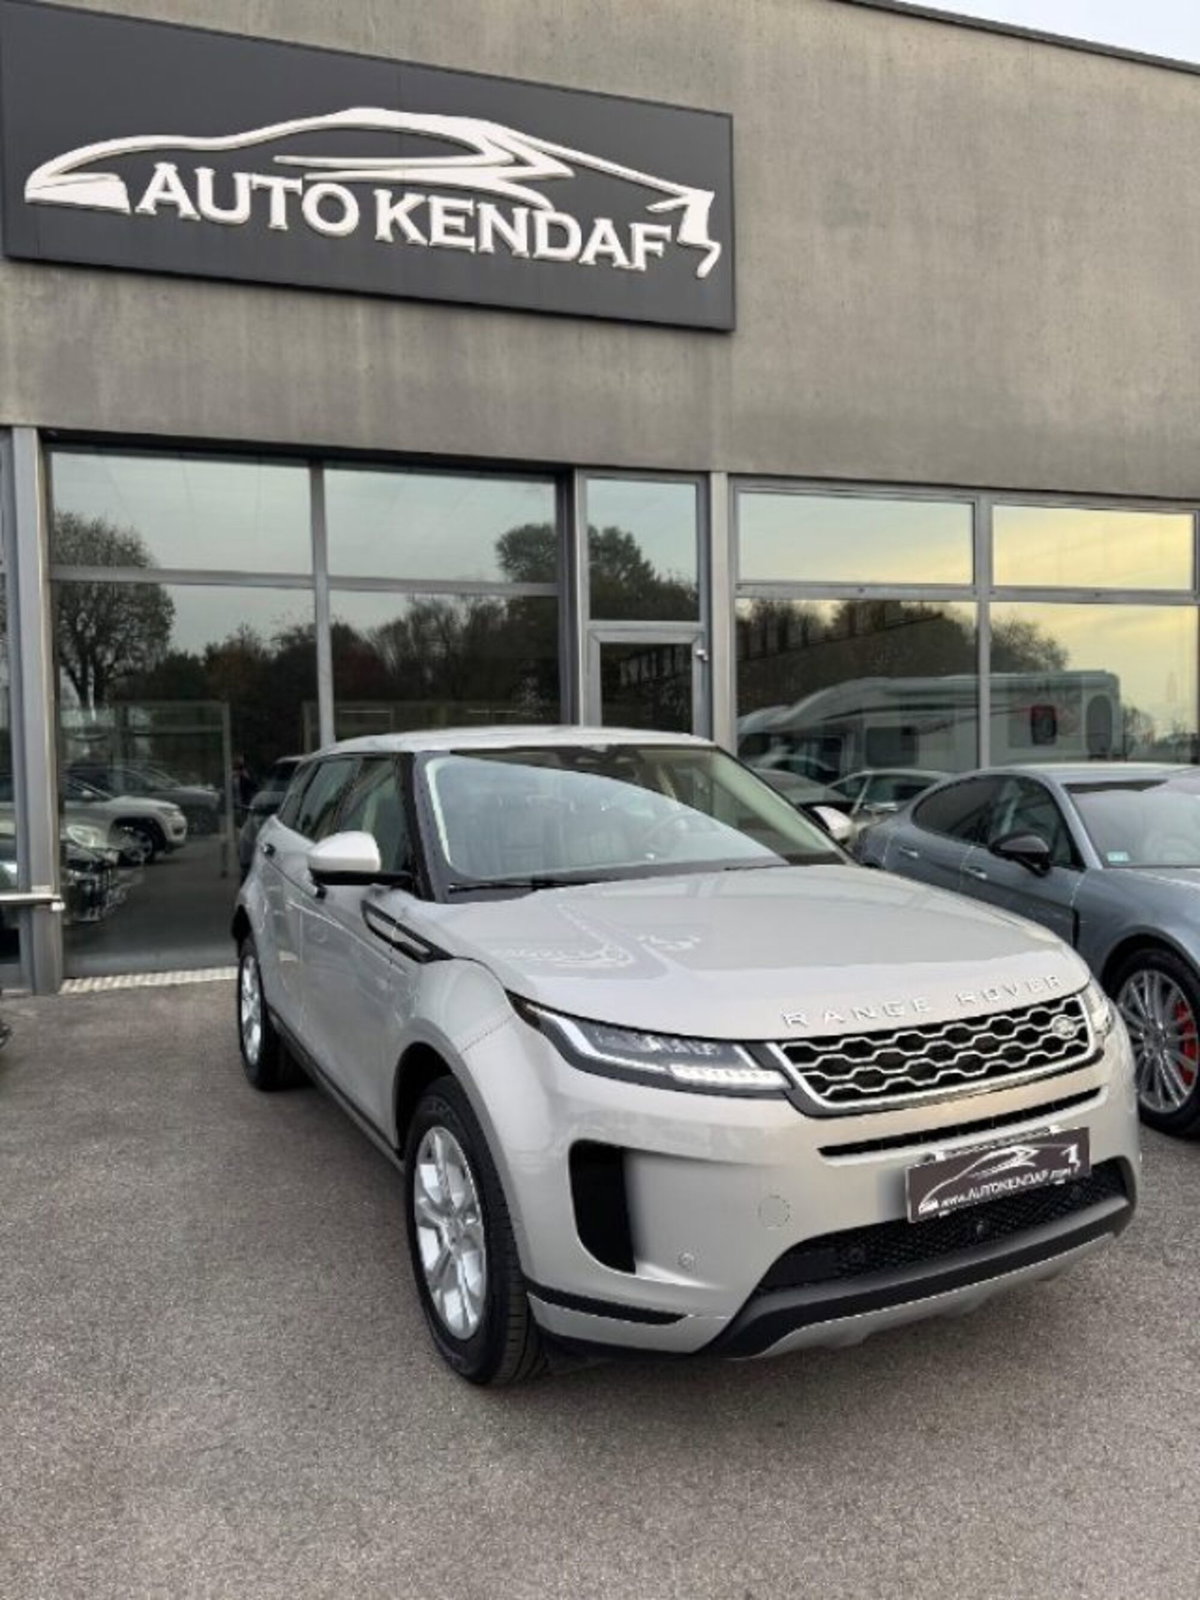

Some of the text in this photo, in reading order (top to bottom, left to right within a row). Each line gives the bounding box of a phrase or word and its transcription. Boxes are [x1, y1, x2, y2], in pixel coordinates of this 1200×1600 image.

[137, 162, 672, 271] AUTO KENDAF
[782, 974, 1063, 1028] RANGE ROVER
